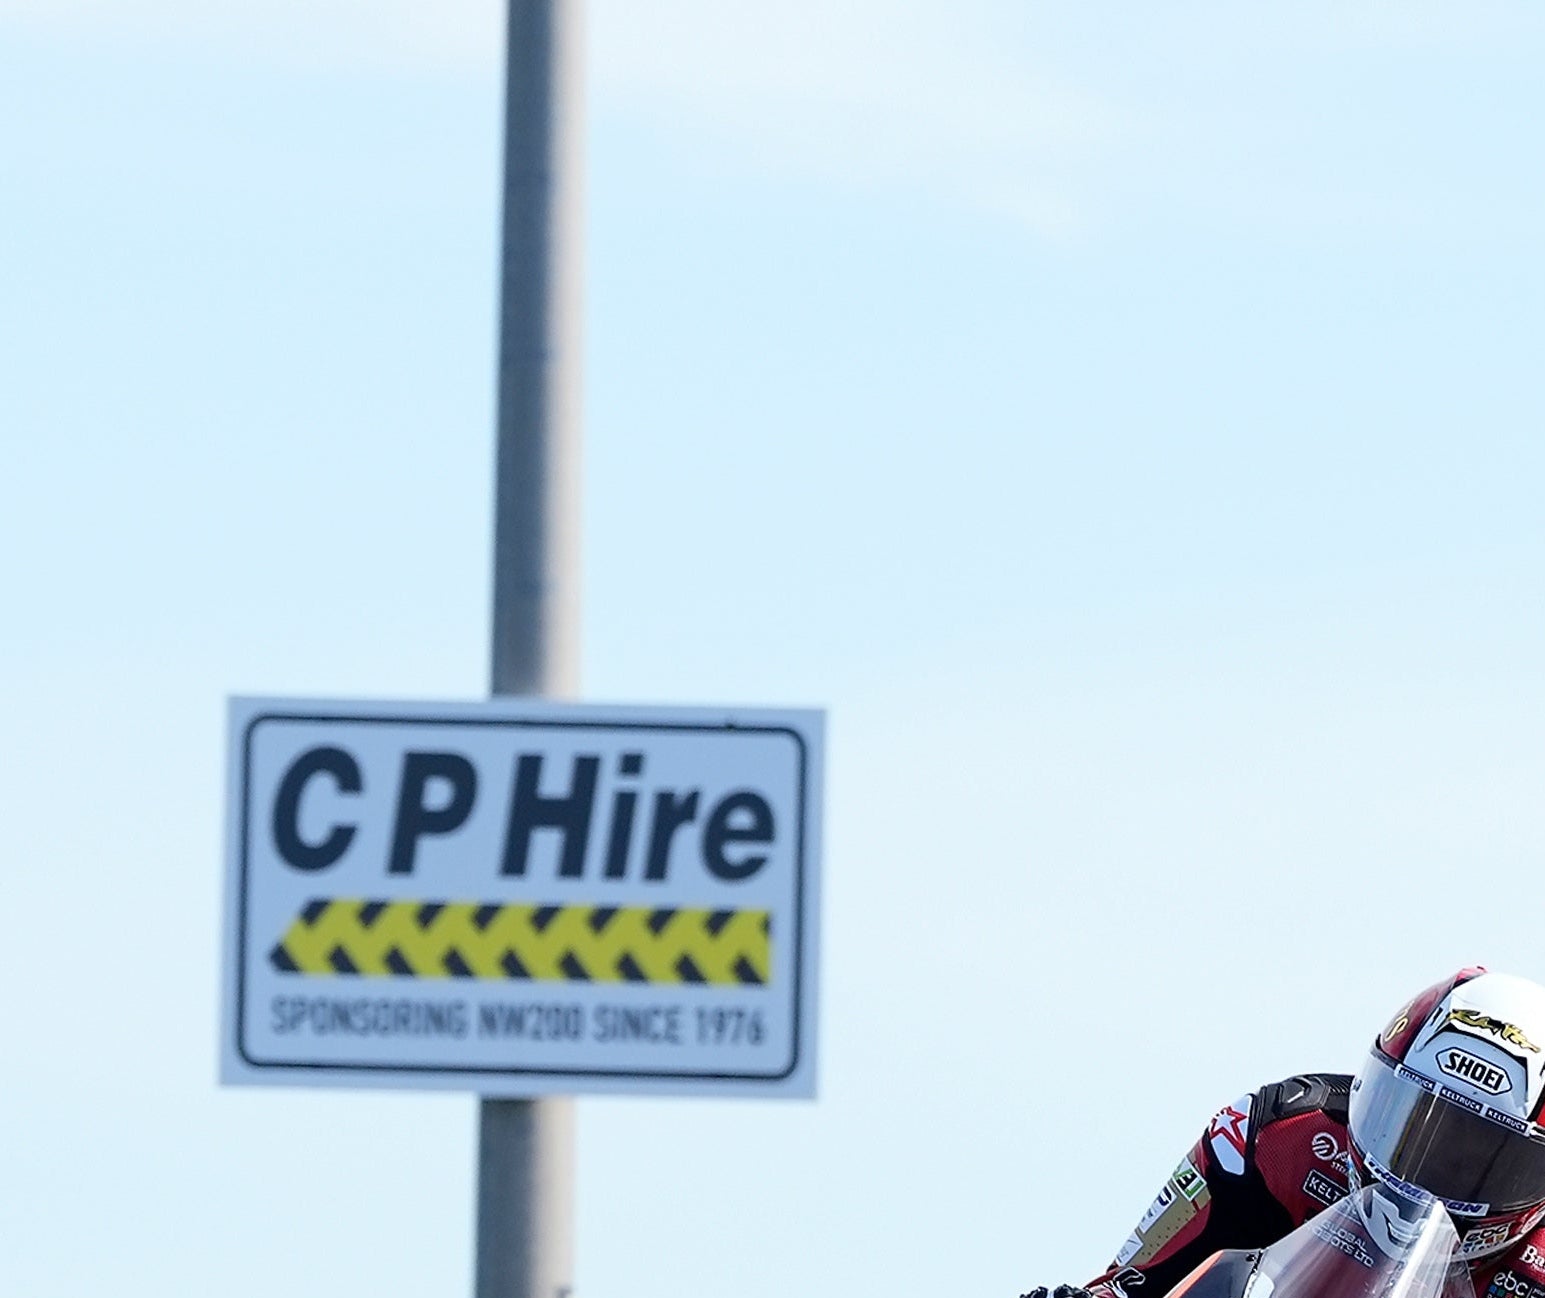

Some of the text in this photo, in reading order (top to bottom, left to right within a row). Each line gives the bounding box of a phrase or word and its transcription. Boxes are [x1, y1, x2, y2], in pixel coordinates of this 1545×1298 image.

[272, 747, 775, 883] C P Hire
[269, 997, 765, 1047] SPONSORING NW200 SINCE 1976
[1444, 1051, 1505, 1092] SHOEI
[1441, 1088, 1483, 1113] KELTRUCK
[1487, 1109, 1527, 1131] KELTRUCK
[1493, 1270, 1529, 1297] ebc
